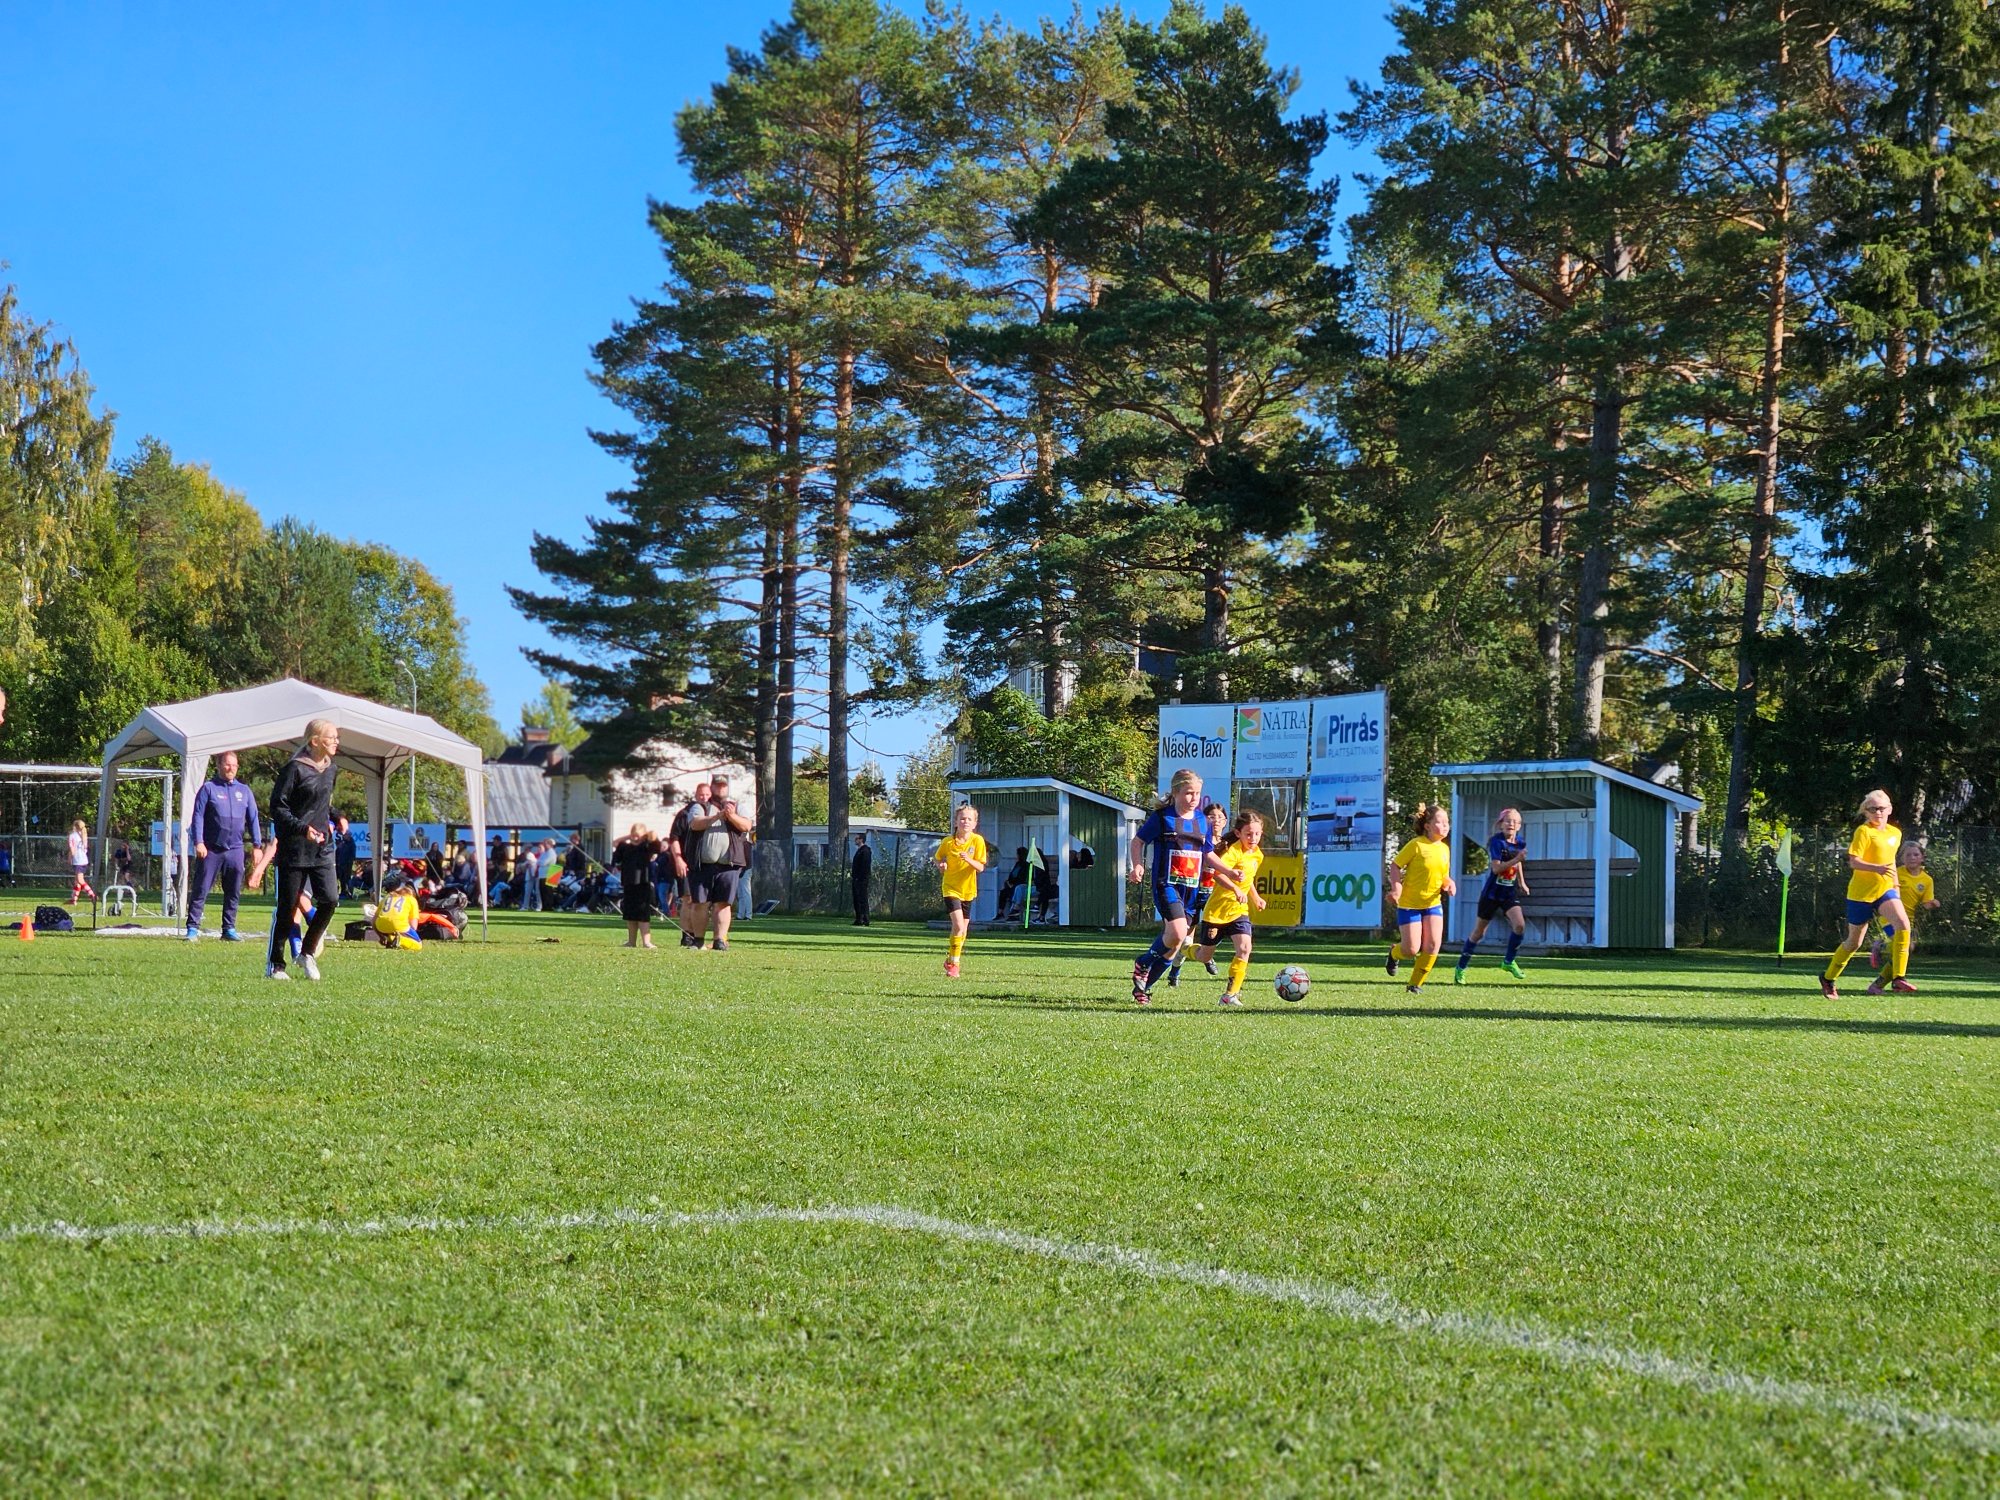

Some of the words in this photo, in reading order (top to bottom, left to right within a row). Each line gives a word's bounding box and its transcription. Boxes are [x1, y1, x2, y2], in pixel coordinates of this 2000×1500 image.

[1262, 707, 1307, 730] NÄTRA
[1329, 712, 1379, 744] Pirrås
[1162, 736, 1198, 758] Näske
[1200, 736, 1222, 758] Taxi
[1254, 870, 1296, 895] alux
[1312, 873, 1376, 910] coop
[1265, 898, 1296, 910] lutions
